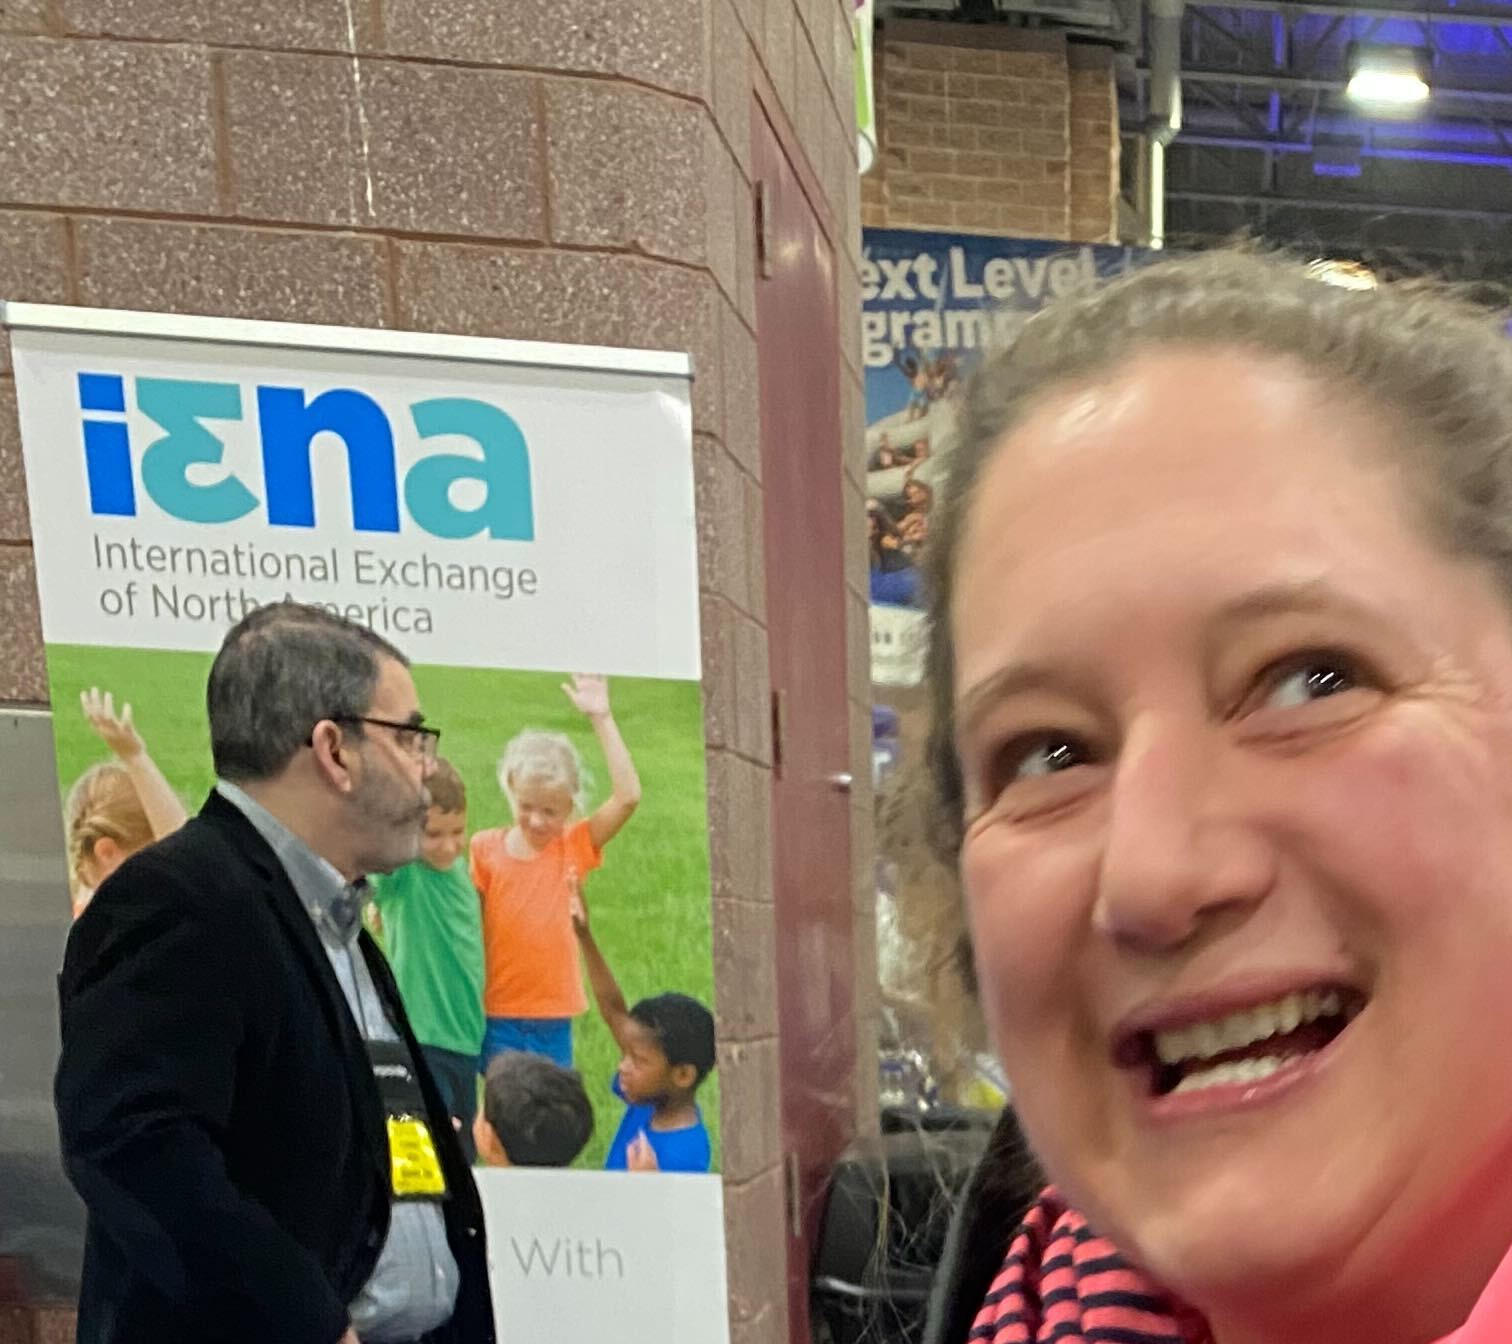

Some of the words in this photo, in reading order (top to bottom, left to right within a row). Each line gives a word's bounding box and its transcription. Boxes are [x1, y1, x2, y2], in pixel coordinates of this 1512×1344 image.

[951, 246, 1096, 300] Level
[93, 532, 338, 584] International
[354, 549, 537, 600] Exchange
[100, 581, 138, 616] of
[511, 1236, 624, 1279] With
